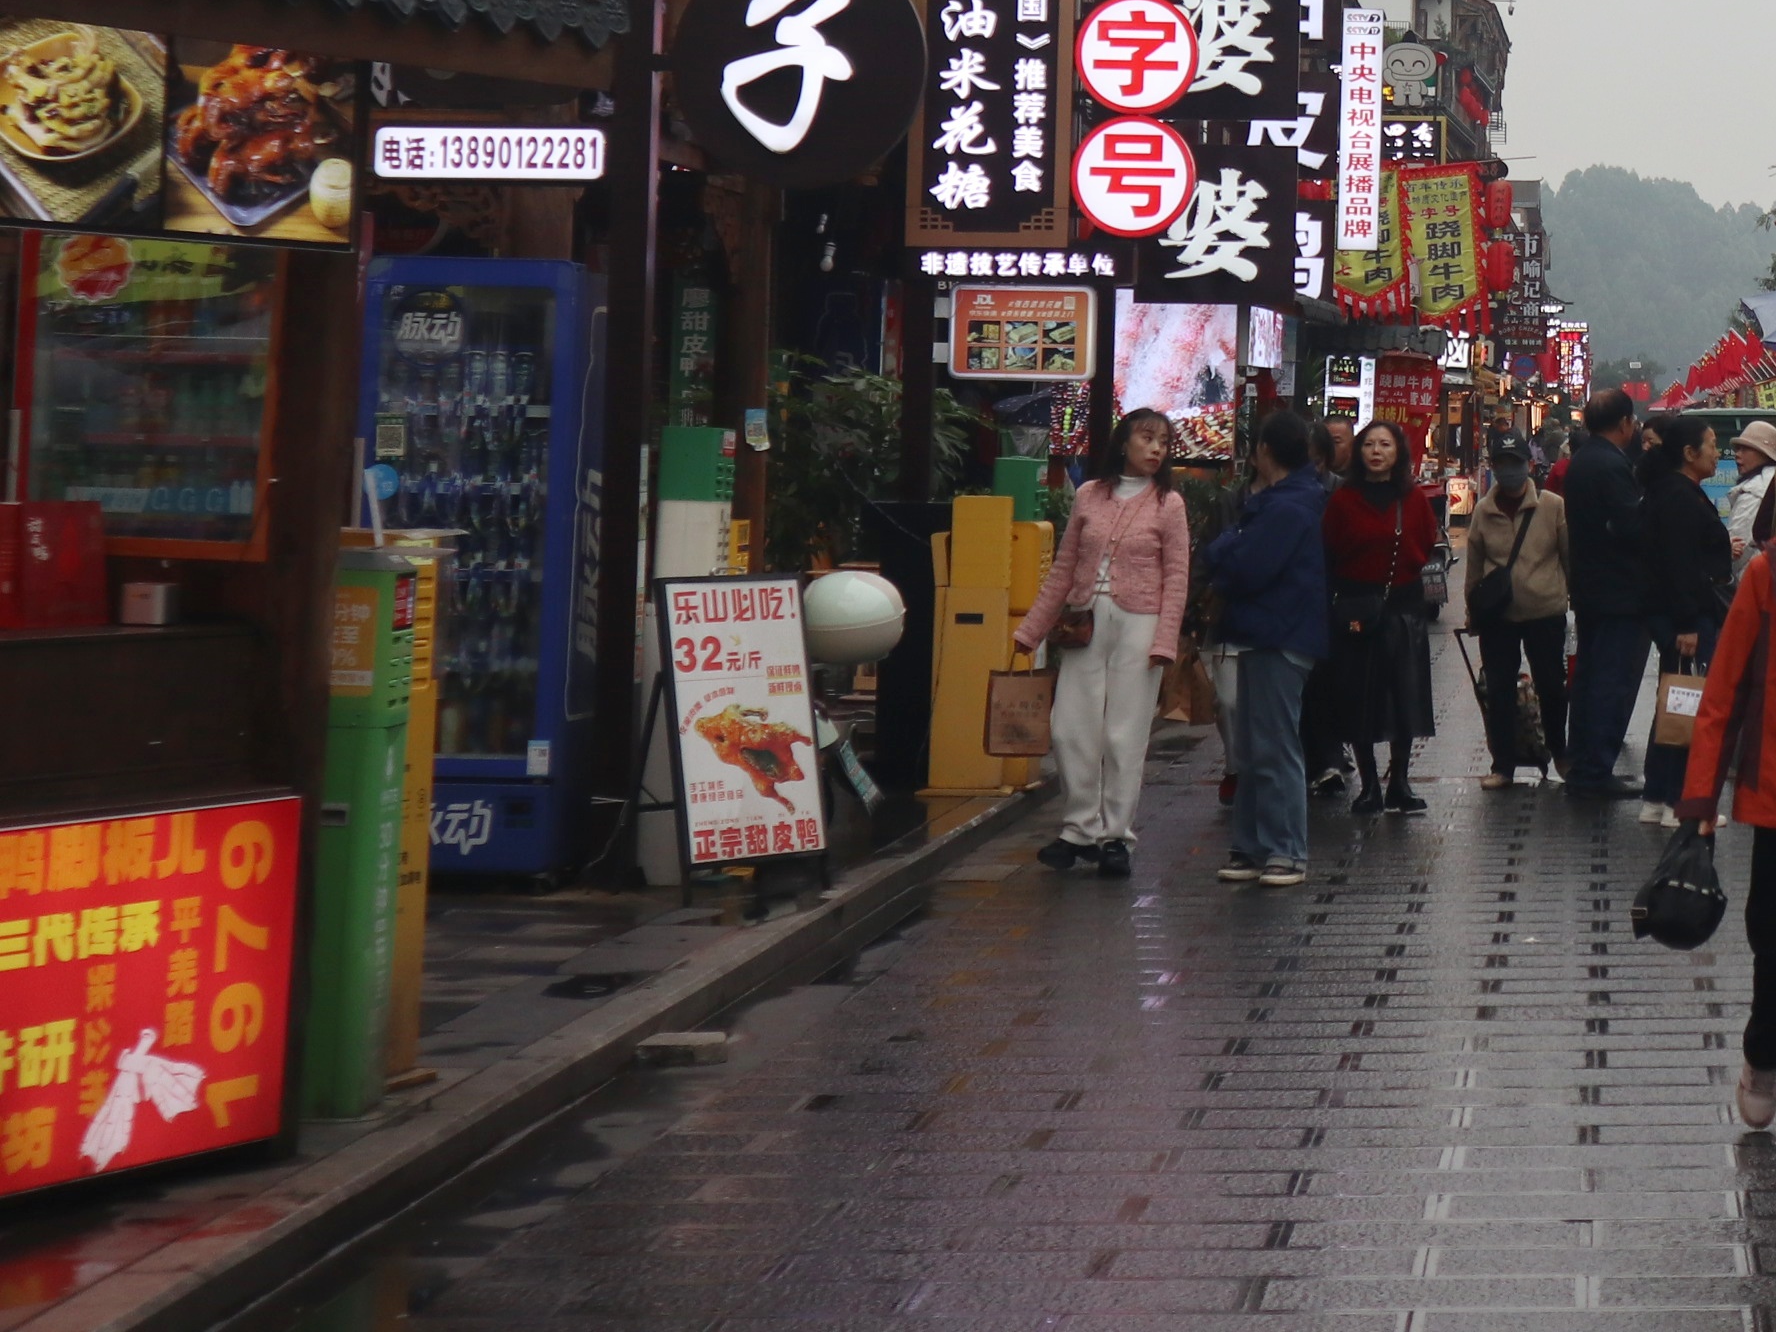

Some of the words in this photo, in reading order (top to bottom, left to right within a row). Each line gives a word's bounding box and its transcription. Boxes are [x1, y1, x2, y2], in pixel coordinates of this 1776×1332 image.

[1344, 42, 1376, 238] 中央电视台展播品牌
[921, 252, 1115, 276] 非遗技艺传承单位
[1425, 220, 1465, 302] 跷脚牛肉
[396, 311, 463, 347] 脉动
[1379, 374, 1433, 390] 跷脚牛肉
[693, 818, 820, 862] 正宗甜皮鸭
[0, 900, 161, 973] 三代传承
